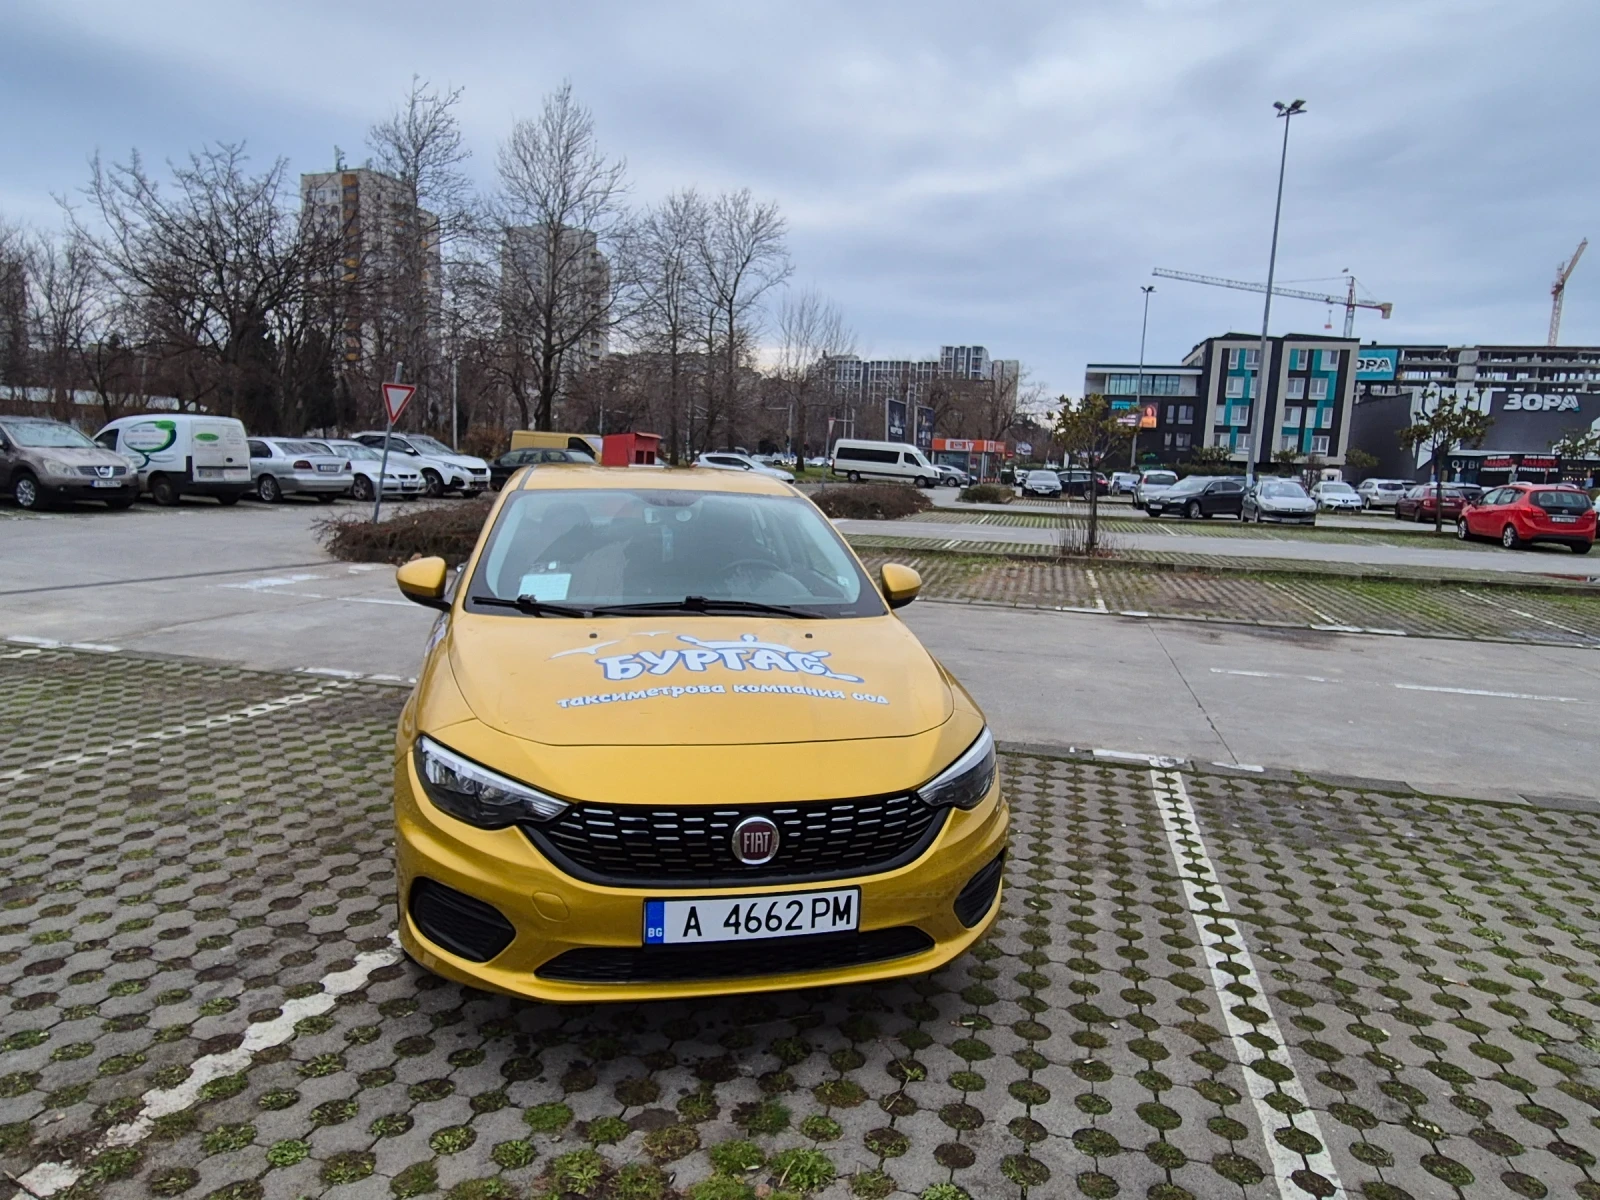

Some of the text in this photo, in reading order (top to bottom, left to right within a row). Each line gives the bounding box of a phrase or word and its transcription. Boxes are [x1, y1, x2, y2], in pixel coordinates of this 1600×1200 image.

[1356, 357, 1392, 372] ОРА
[1503, 393, 1580, 412] ЗОРА
[597, 647, 864, 682] БУРГАС
[557, 682, 889, 709] таксиметрова компания оод
[743, 831, 771, 853] FIAT
[647, 928, 663, 938] BG
